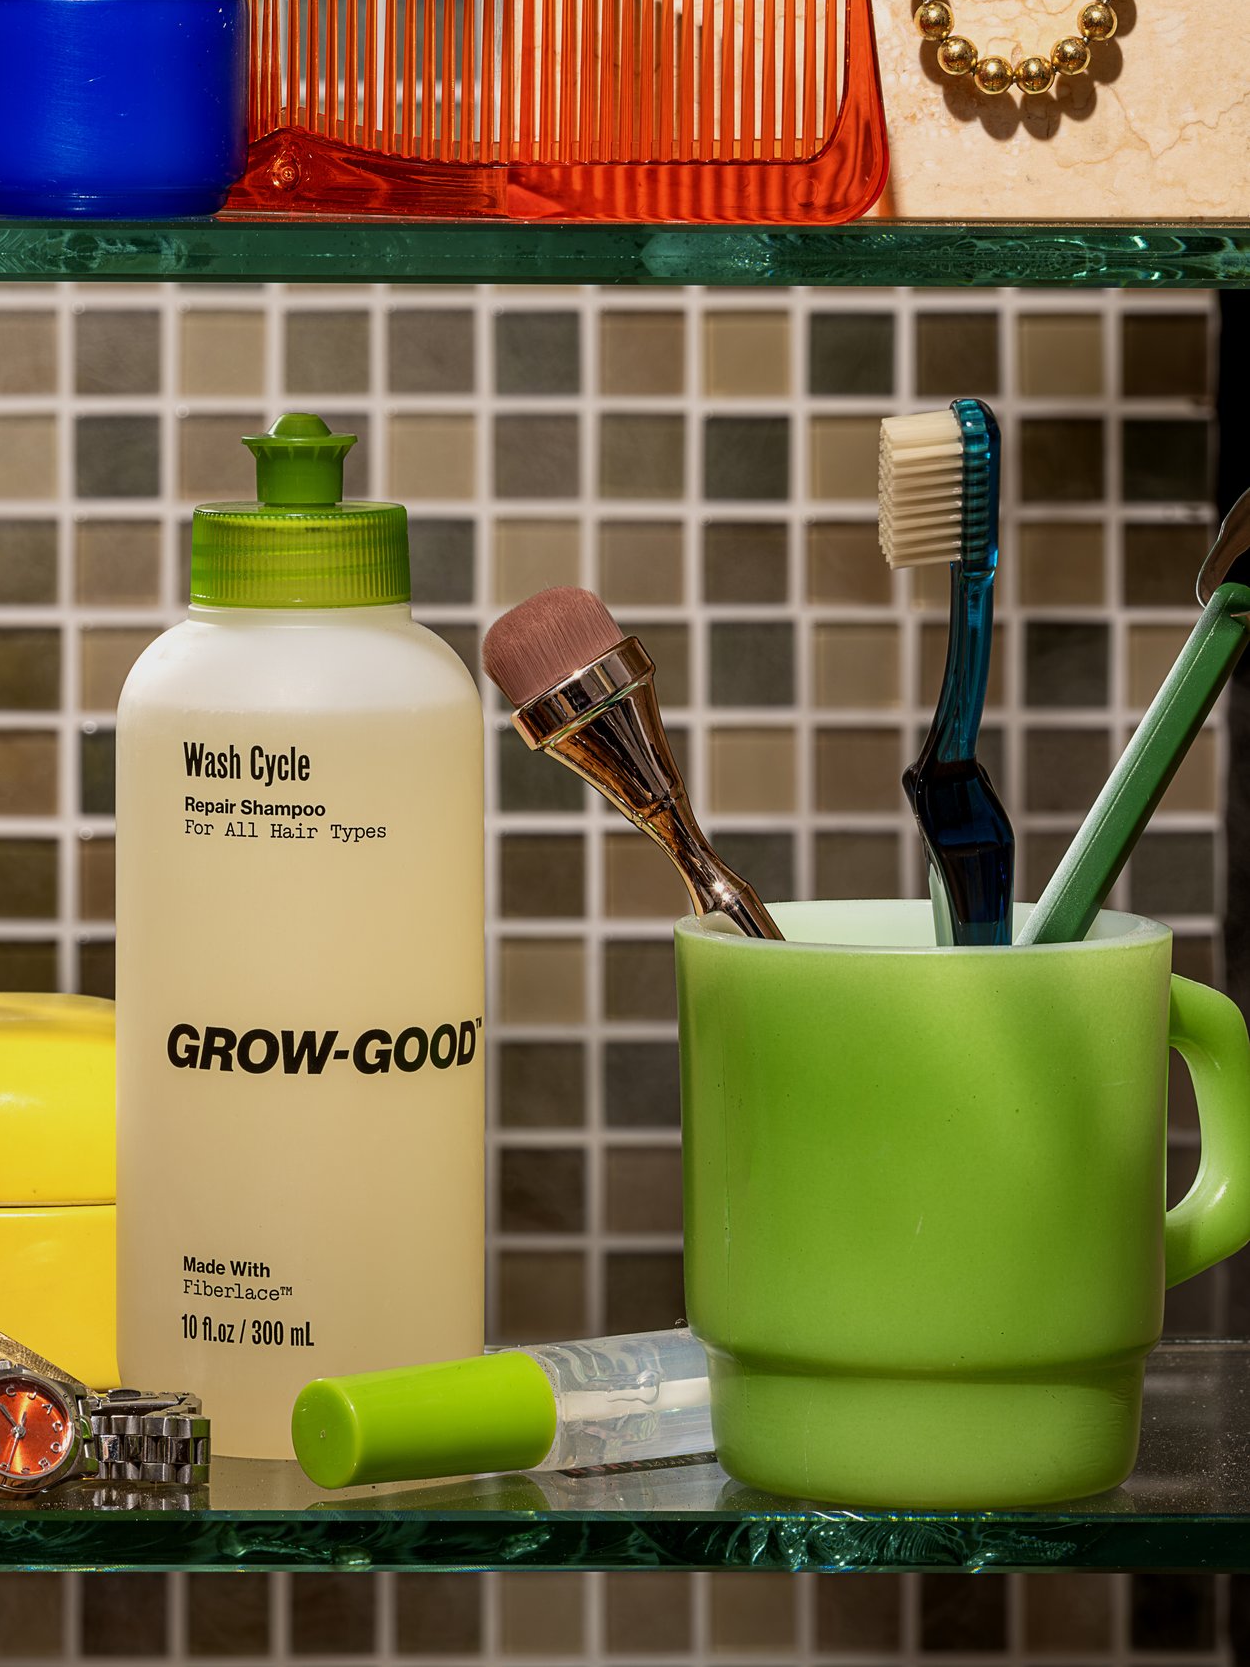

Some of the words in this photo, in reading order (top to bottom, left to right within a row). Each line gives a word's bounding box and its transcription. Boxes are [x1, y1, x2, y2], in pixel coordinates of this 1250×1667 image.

[183, 741, 241, 780] Wash
[250, 745, 311, 787] Cycle
[185, 796, 237, 817] Repair
[240, 799, 326, 820] Shampoo
[184, 819, 215, 836] For
[224, 821, 259, 838] All
[270, 822, 319, 839] Hair
[330, 824, 387, 843] Types
[183, 1255, 226, 1276] Made
[229, 1260, 271, 1278] With
[181, 1313, 198, 1340] 10
[201, 1316, 235, 1344] fl.oz
[239, 1319, 247, 1344] /
[251, 1319, 284, 1346] 300
[290, 1321, 315, 1347] mL
